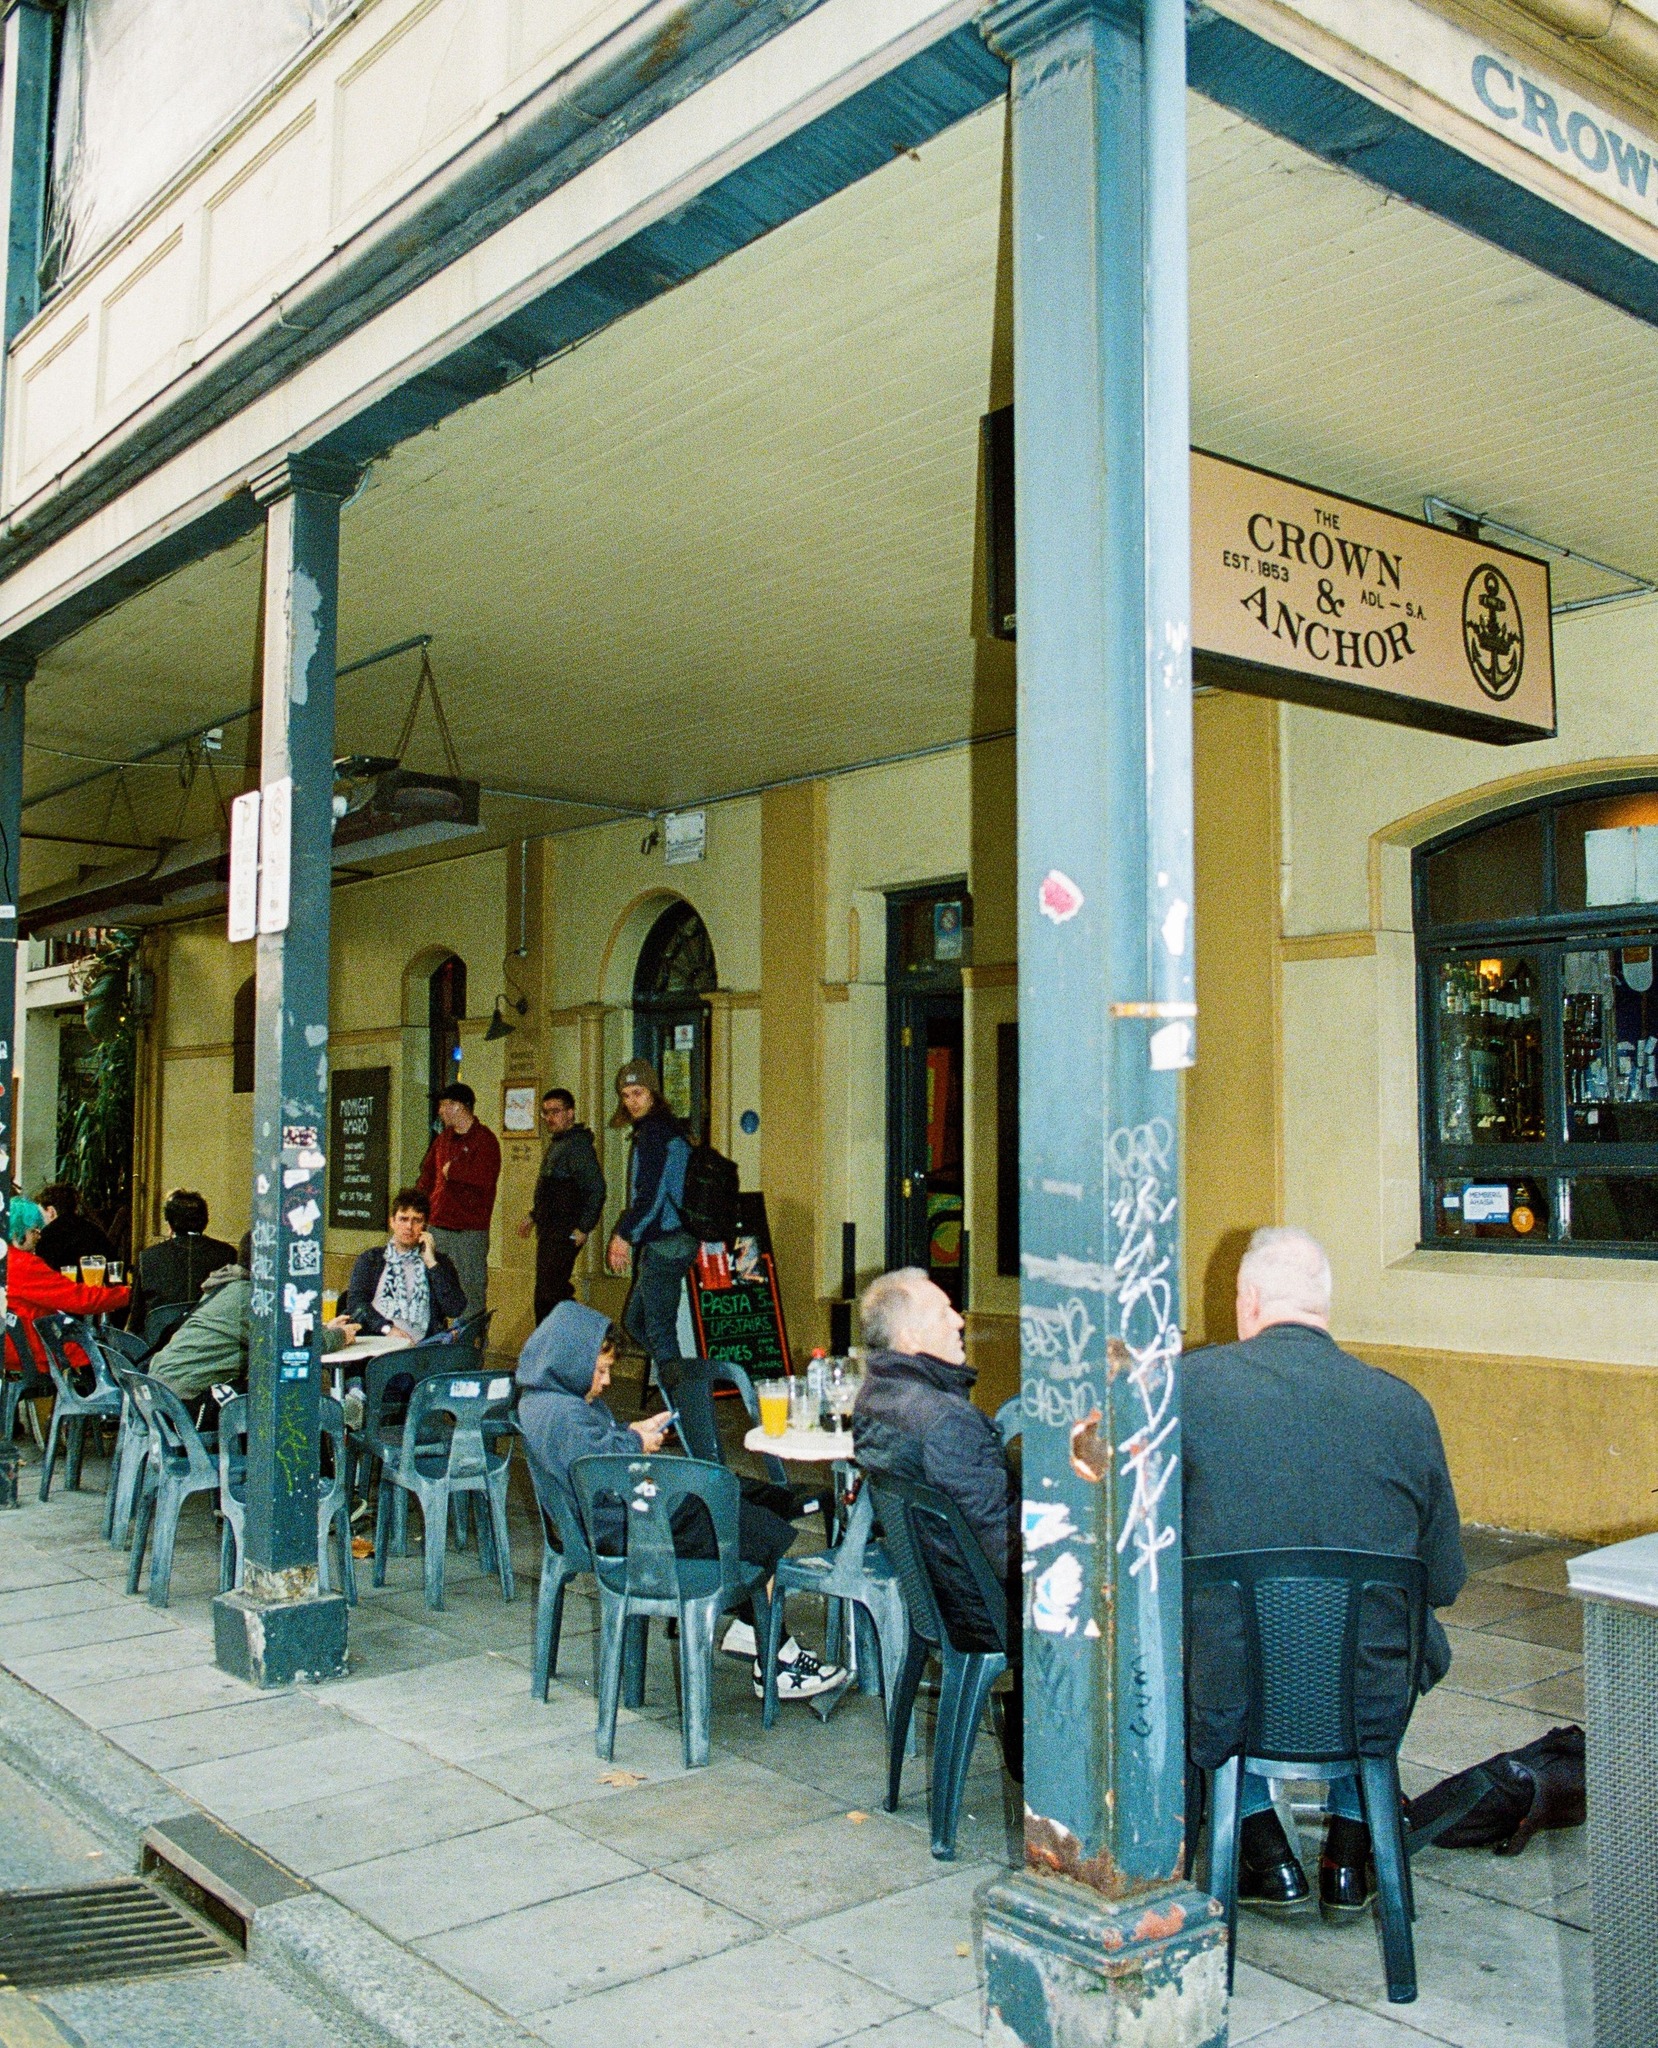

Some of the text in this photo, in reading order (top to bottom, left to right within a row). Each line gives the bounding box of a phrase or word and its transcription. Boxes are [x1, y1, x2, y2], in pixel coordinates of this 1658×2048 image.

[1471, 54, 1658, 206] CROW
[1314, 508, 1341, 530] THE
[1222, 550, 1290, 583] EST. 1853
[1247, 513, 1403, 591] CROWN
[1316, 578, 1345, 618] &
[1360, 589, 1385, 610] ADL
[1405, 602, 1428, 621] S.A.
[1240, 585, 1416, 669] ANCHOR
[701, 1290, 752, 1316] PASTA
[710, 1316, 772, 1337] UPSTAIRS
[708, 1344, 753, 1361] GAMES
